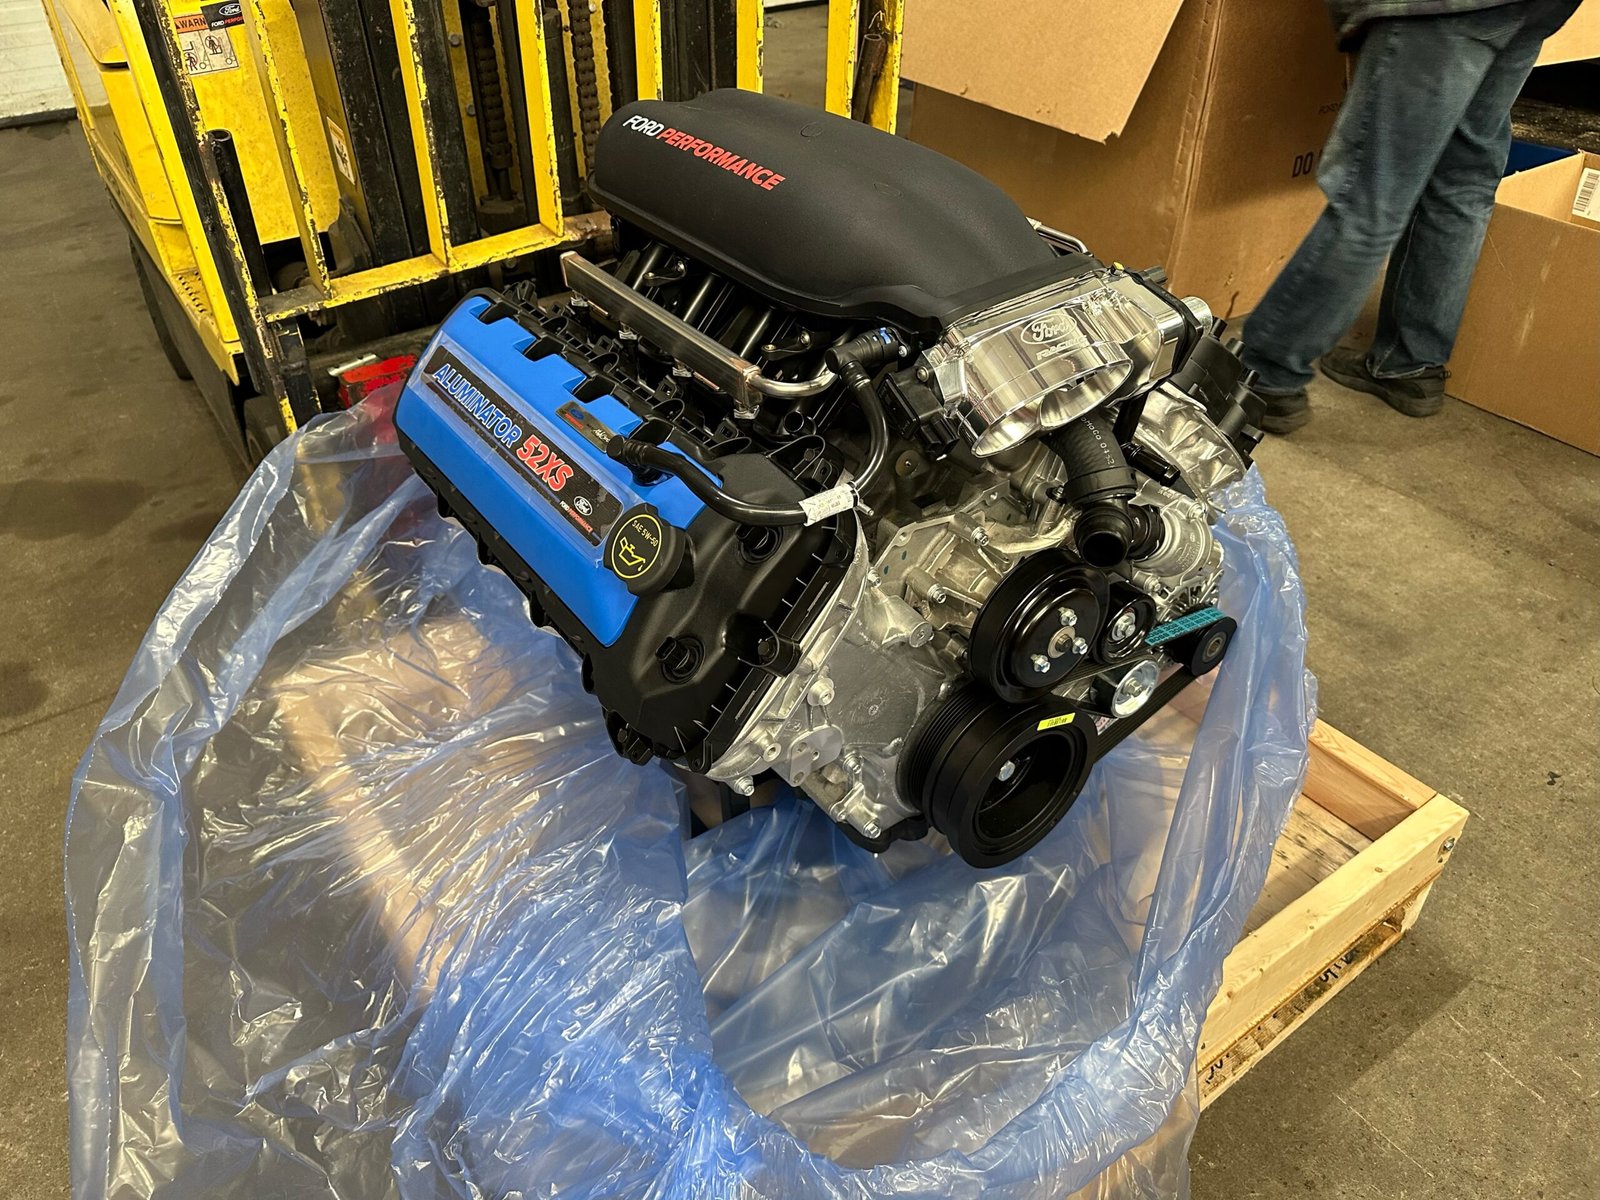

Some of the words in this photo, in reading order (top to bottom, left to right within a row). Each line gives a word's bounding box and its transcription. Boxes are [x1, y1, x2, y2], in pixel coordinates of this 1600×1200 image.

[211, 20, 225, 28] FORD
[622, 115, 665, 137] FORD
[656, 127, 786, 191] PERFORMANCE
[1291, 151, 1314, 178] DO
[1030, 316, 1074, 342] Ford
[433, 363, 523, 449] ALUMINATOR
[516, 434, 574, 492] 52XS
[632, 519, 644, 533] SAE
